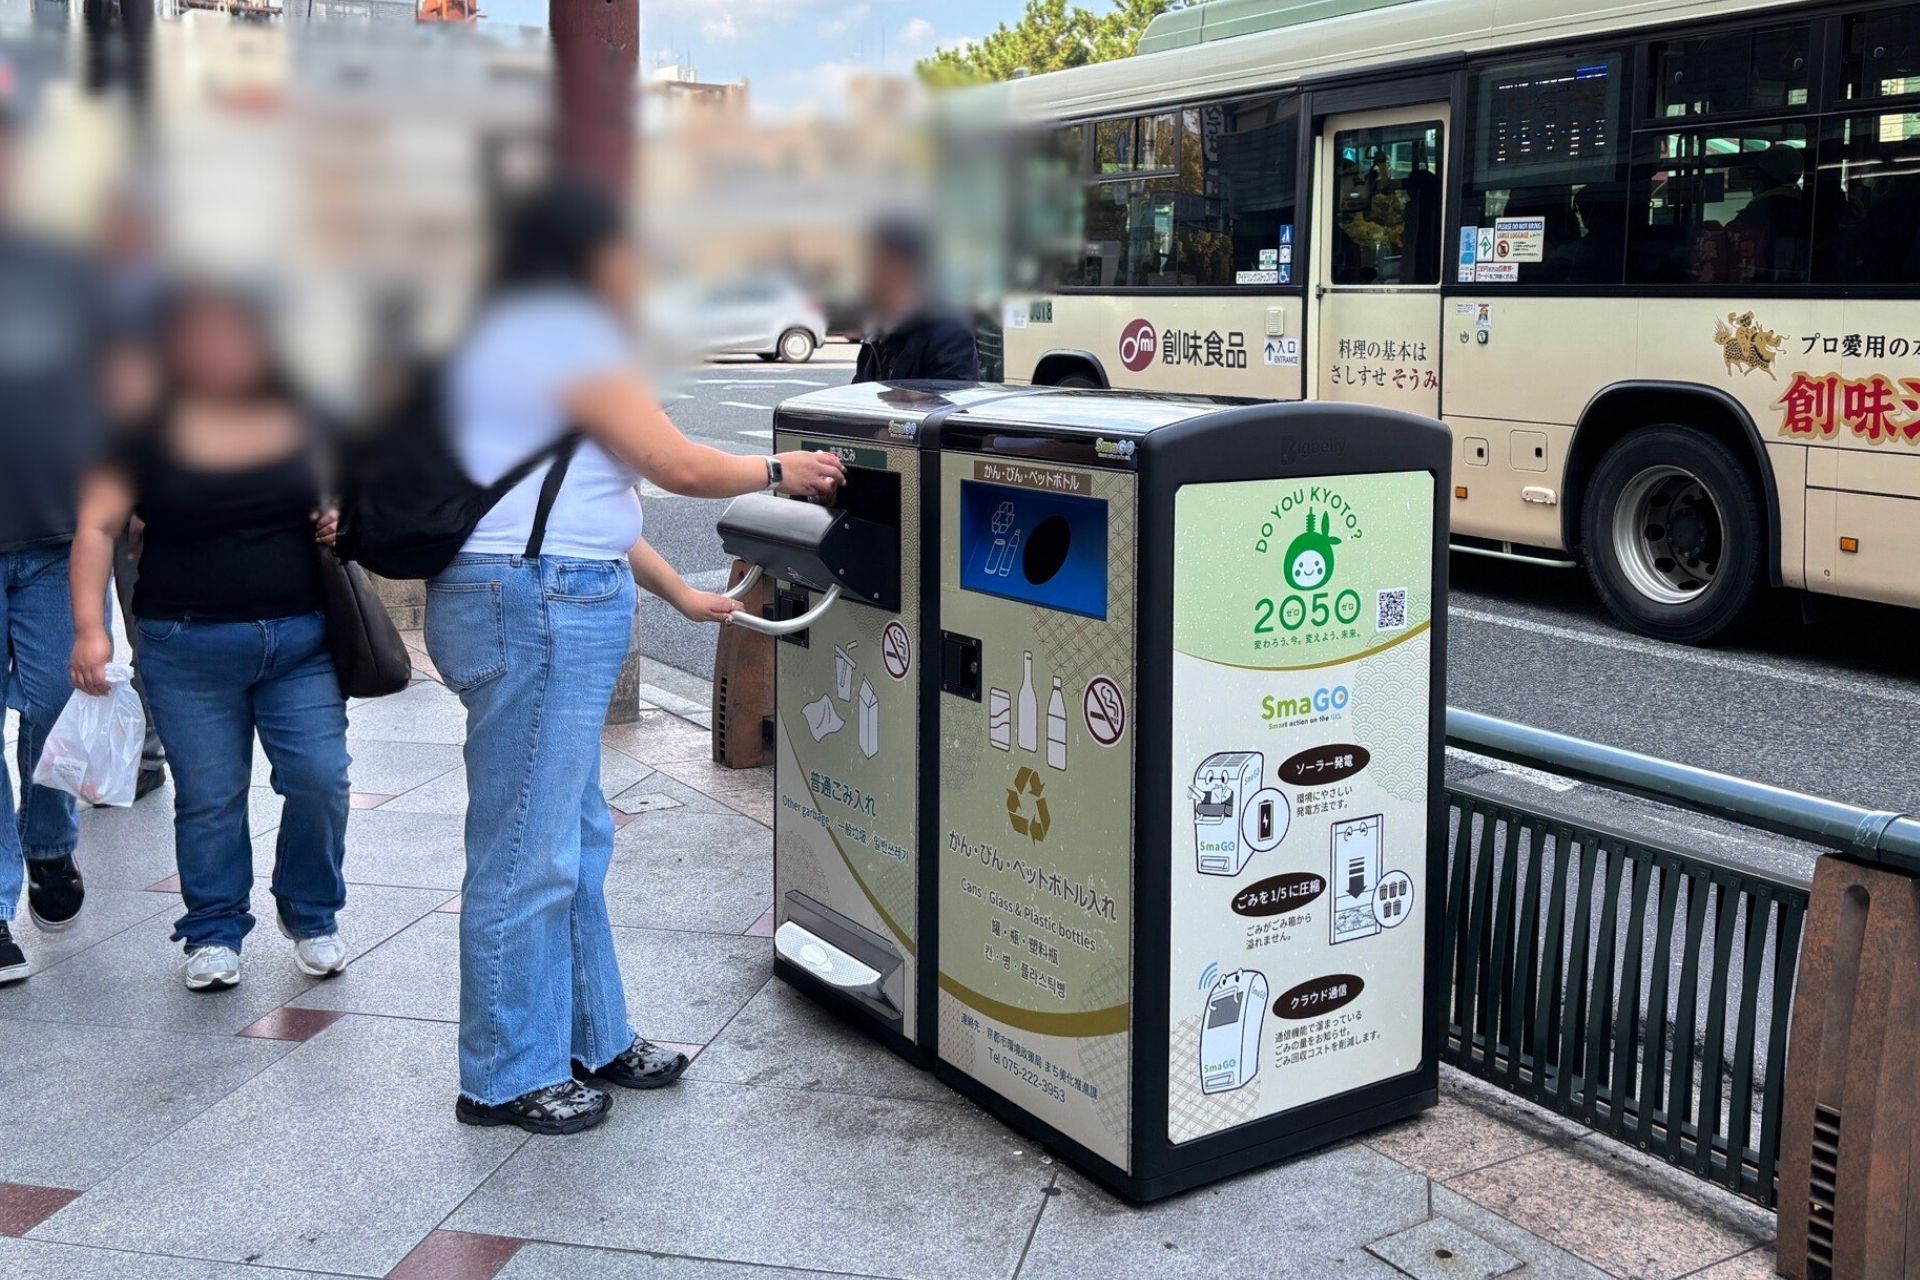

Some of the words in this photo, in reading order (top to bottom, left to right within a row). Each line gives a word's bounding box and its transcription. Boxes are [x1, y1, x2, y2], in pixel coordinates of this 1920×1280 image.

[1162, 329, 1247, 368] 創味食品
[1276, 341, 1296, 354] 入口
[1338, 338, 1427, 361] 料理の基本は
[1095, 437, 1135, 456] SmaGO
[983, 463, 1079, 491] かん・びん・ペットボトル
[1255, 522, 1274, 554] DO
[1271, 488, 1304, 520] YOU
[1310, 486, 1363, 541] KYOTO?
[1254, 588, 1361, 634] 2050
[1262, 685, 1349, 720] SmaGO
[1289, 719, 1309, 728] action
[1319, 714, 1329, 722] the
[1296, 754, 1354, 775] ソーラー発電
[810, 771, 876, 817] 普通ごみ入れ
[1296, 786, 1353, 804] 環境にやさしい
[783, 795, 801, 811] Other
[802, 806, 830, 827] garbage
[1296, 799, 1348, 818] 発電方法です。
[1200, 841, 1235, 852] SmaGO
[949, 830, 1117, 921] かん・びん・ペットボトル入れ
[989, 891, 1013, 913] Glass
[1014, 904, 1022, 917] &
[1024, 907, 1058, 934] Plastic
[1058, 920, 1096, 952] bottles
[1246, 913, 1312, 937] ごみがごみ箱から
[1245, 932, 1291, 951] 溢れません。
[1290, 983, 1348, 1010] クラウド通信
[1275, 1010, 1363, 1043] 通信機能で溜まっている
[1275, 1030, 1380, 1068] ごみ回収コストを削減します。
[988, 1046, 1001, 1064] Tel
[1002, 1056, 1066, 1103] 075-222-3953
[1204, 1058, 1236, 1073] SmaGO
